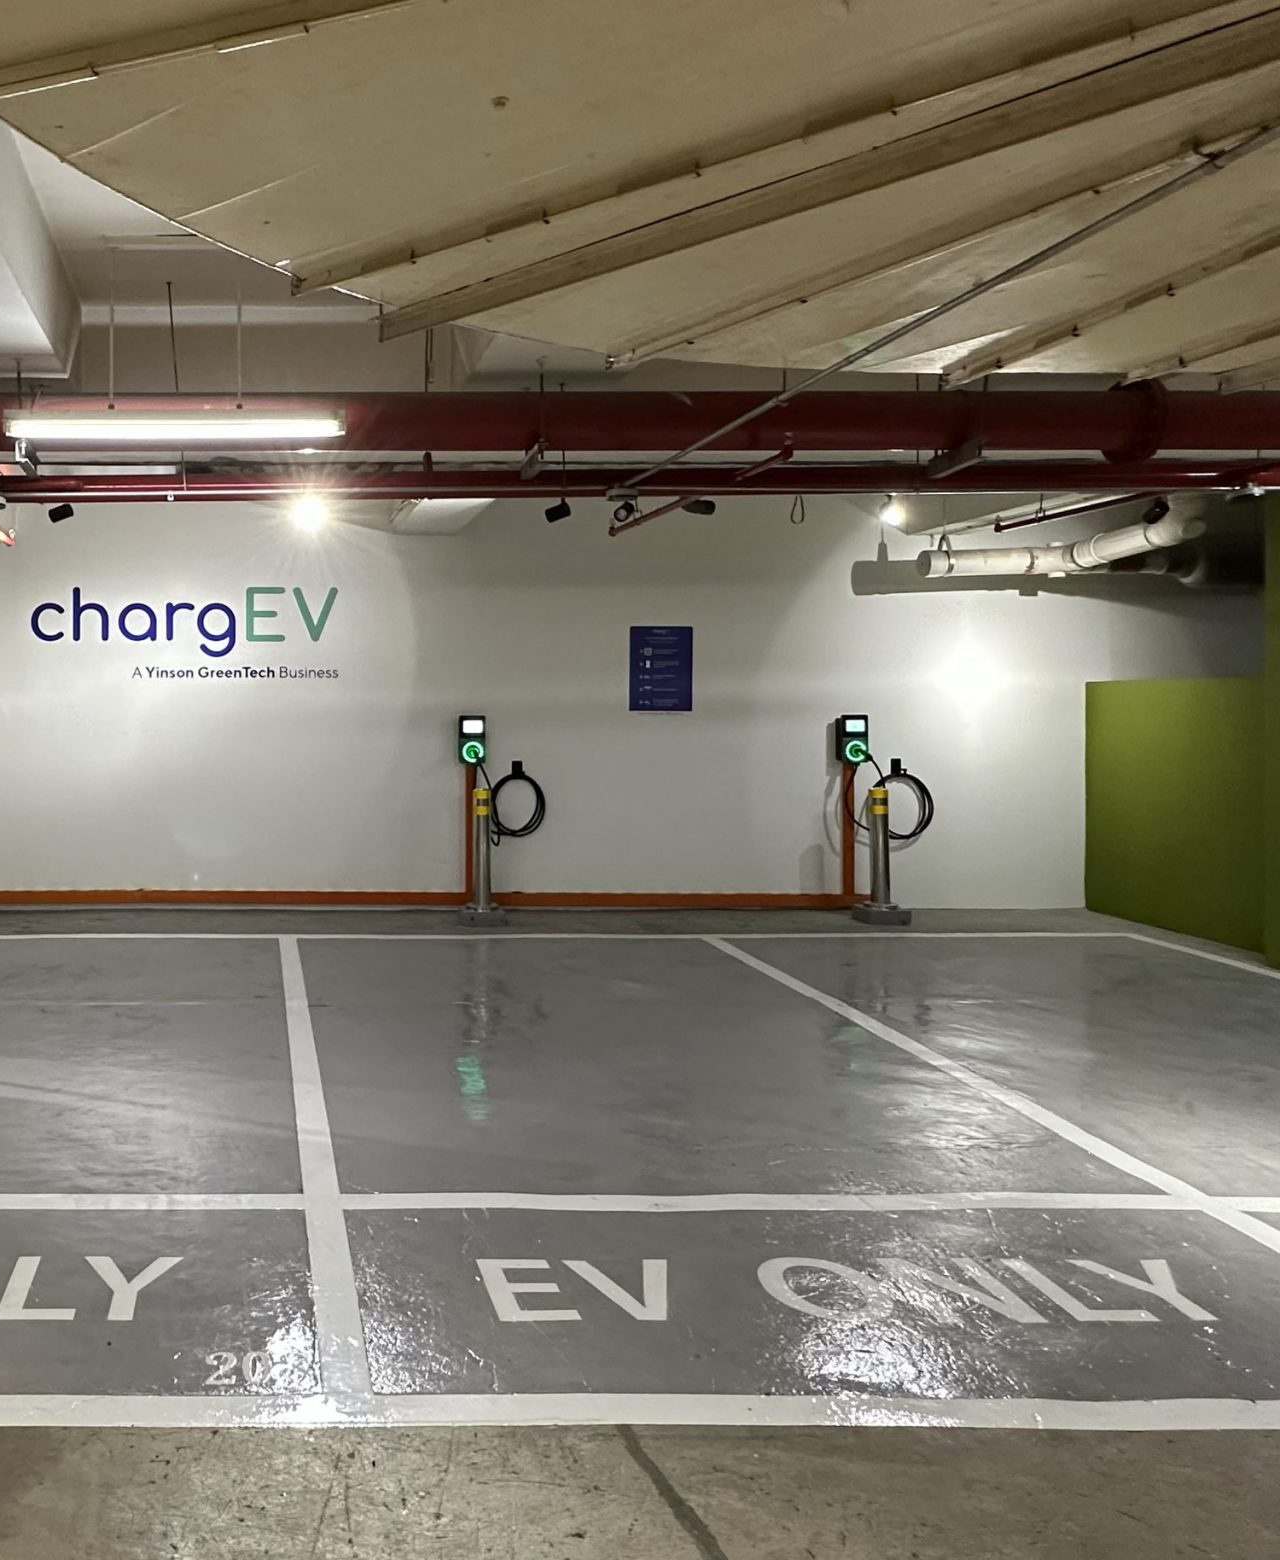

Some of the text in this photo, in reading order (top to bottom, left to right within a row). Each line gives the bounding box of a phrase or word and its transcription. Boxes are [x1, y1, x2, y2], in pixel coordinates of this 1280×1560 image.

[30, 586, 339, 658] chargEV
[131, 666, 339, 679] A Yinson GreenTech Business
[475, 1256, 1220, 1324] EV ONLY
